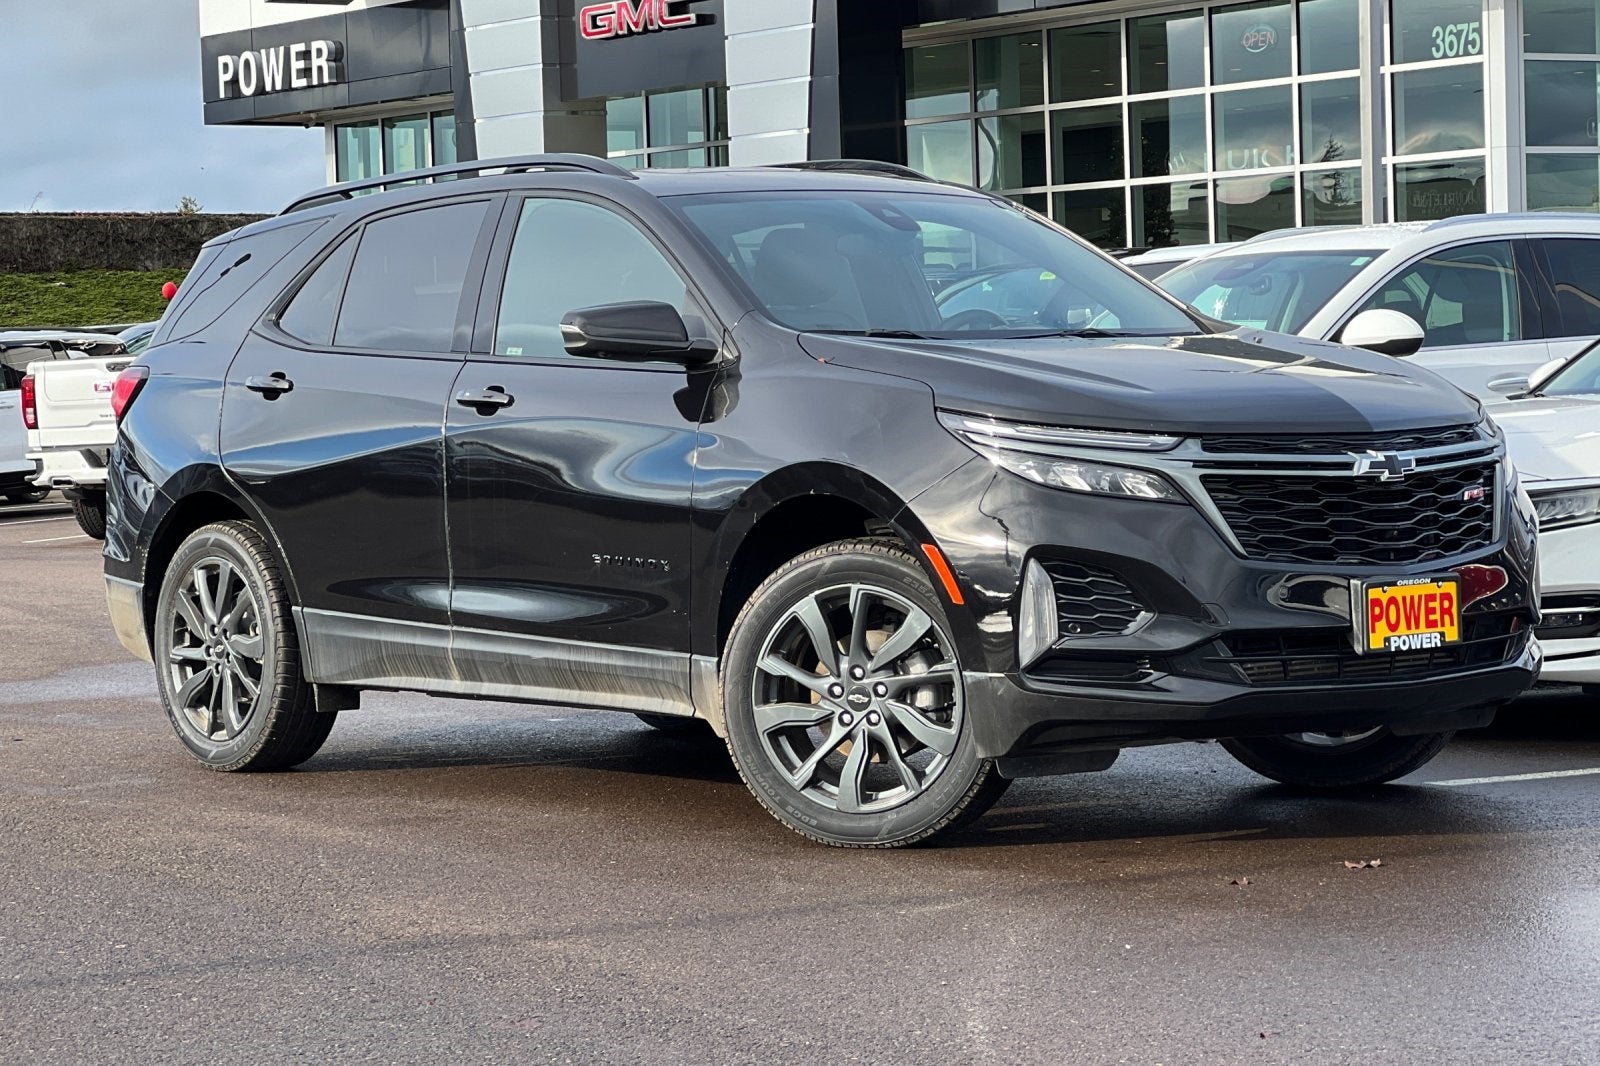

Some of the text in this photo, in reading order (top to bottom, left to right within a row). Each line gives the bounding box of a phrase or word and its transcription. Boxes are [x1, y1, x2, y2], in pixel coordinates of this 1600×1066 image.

[580, 0, 696, 39] GMC
[1243, 32, 1275, 47] OPEN
[1431, 21, 1480, 58] 3675
[217, 40, 329, 98] POWER
[1463, 487, 1484, 500] RS
[591, 553, 669, 572] EQUINOX
[1396, 578, 1431, 586] OREGON
[1369, 592, 1455, 633] POWER
[1390, 632, 1441, 651] POWER
